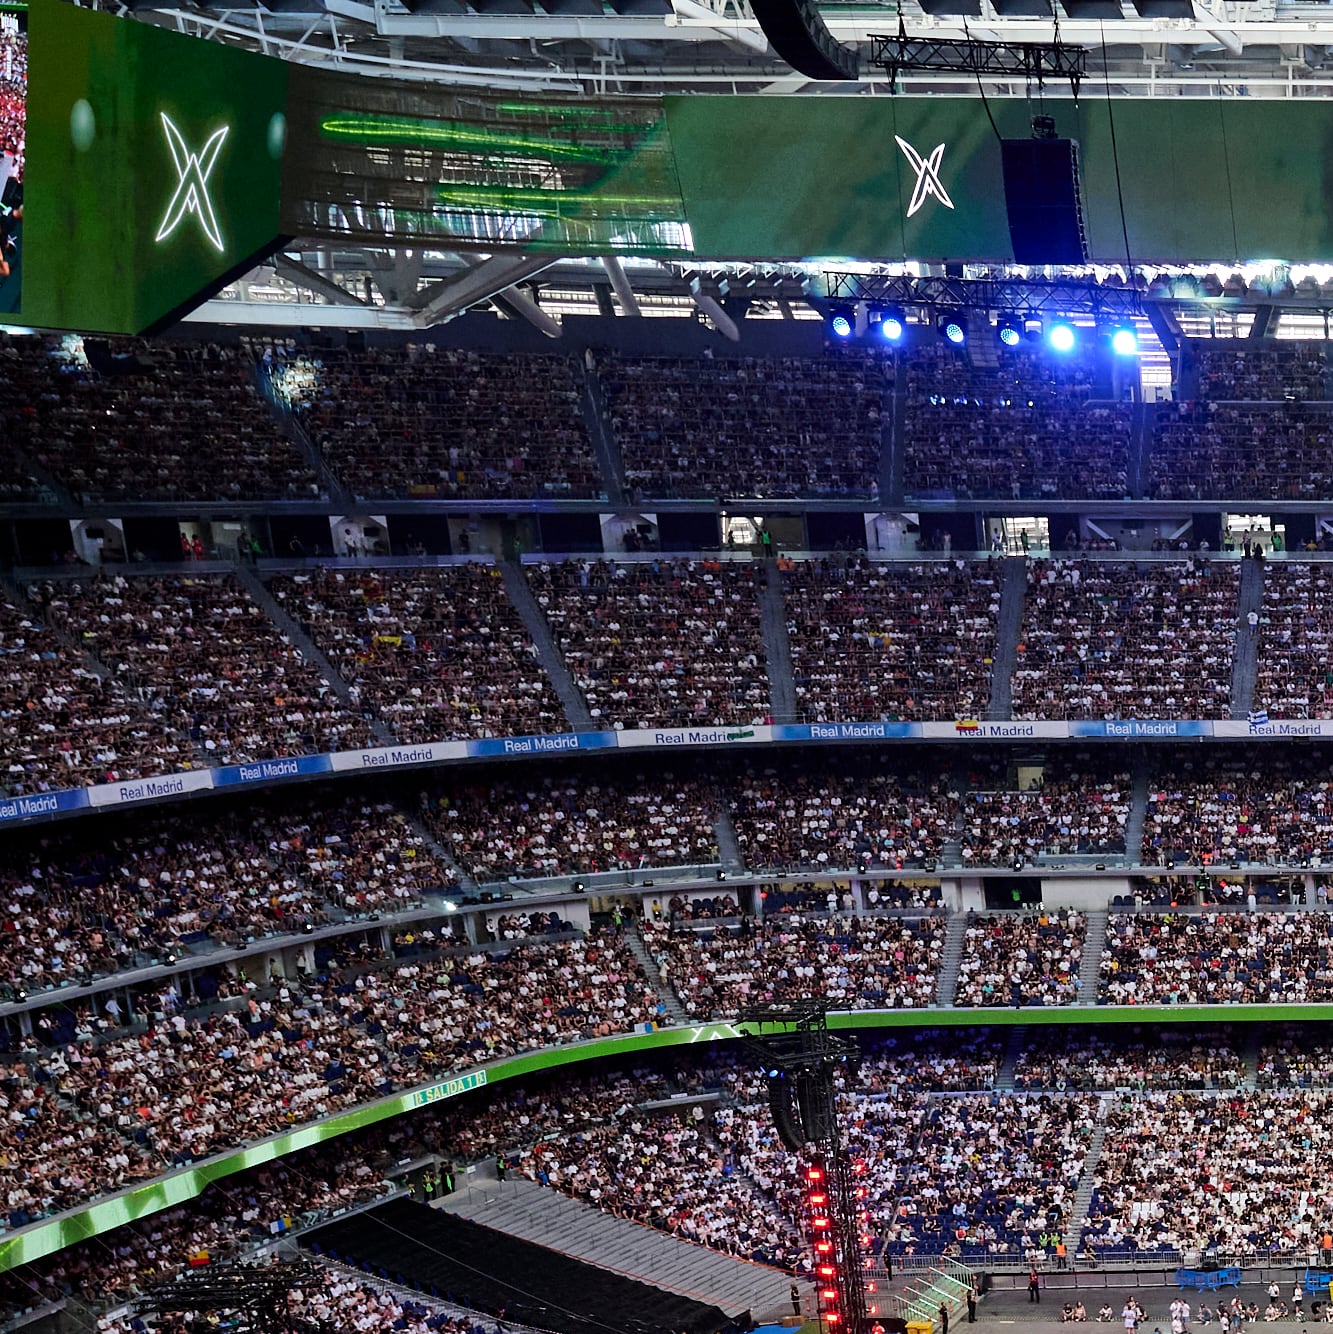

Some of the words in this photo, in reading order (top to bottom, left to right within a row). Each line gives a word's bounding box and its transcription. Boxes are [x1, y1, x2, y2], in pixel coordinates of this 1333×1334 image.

[810, 726, 838, 737] Real
[842, 725, 885, 737] Madrid
[991, 725, 1033, 736] Madrid
[1105, 723, 1131, 735] Real
[1136, 722, 1176, 735] Madrid
[1249, 724, 1275, 735] Real
[1279, 724, 1320, 735] Madrid
[504, 738, 531, 752] Real
[535, 735, 579, 750] Madrid
[655, 732, 684, 744] Real
[689, 731, 732, 743] Madri
[362, 753, 388, 766] Real
[391, 749, 433, 763] Madrid
[240, 766, 263, 780] Real
[263, 761, 298, 776] Madrid
[120, 785, 144, 800] Real
[147, 780, 183, 796] Madrid
[20, 796, 58, 815] Madrid
[425, 1080, 465, 1100] SALIDA
[466, 1077, 473, 1088] 1
